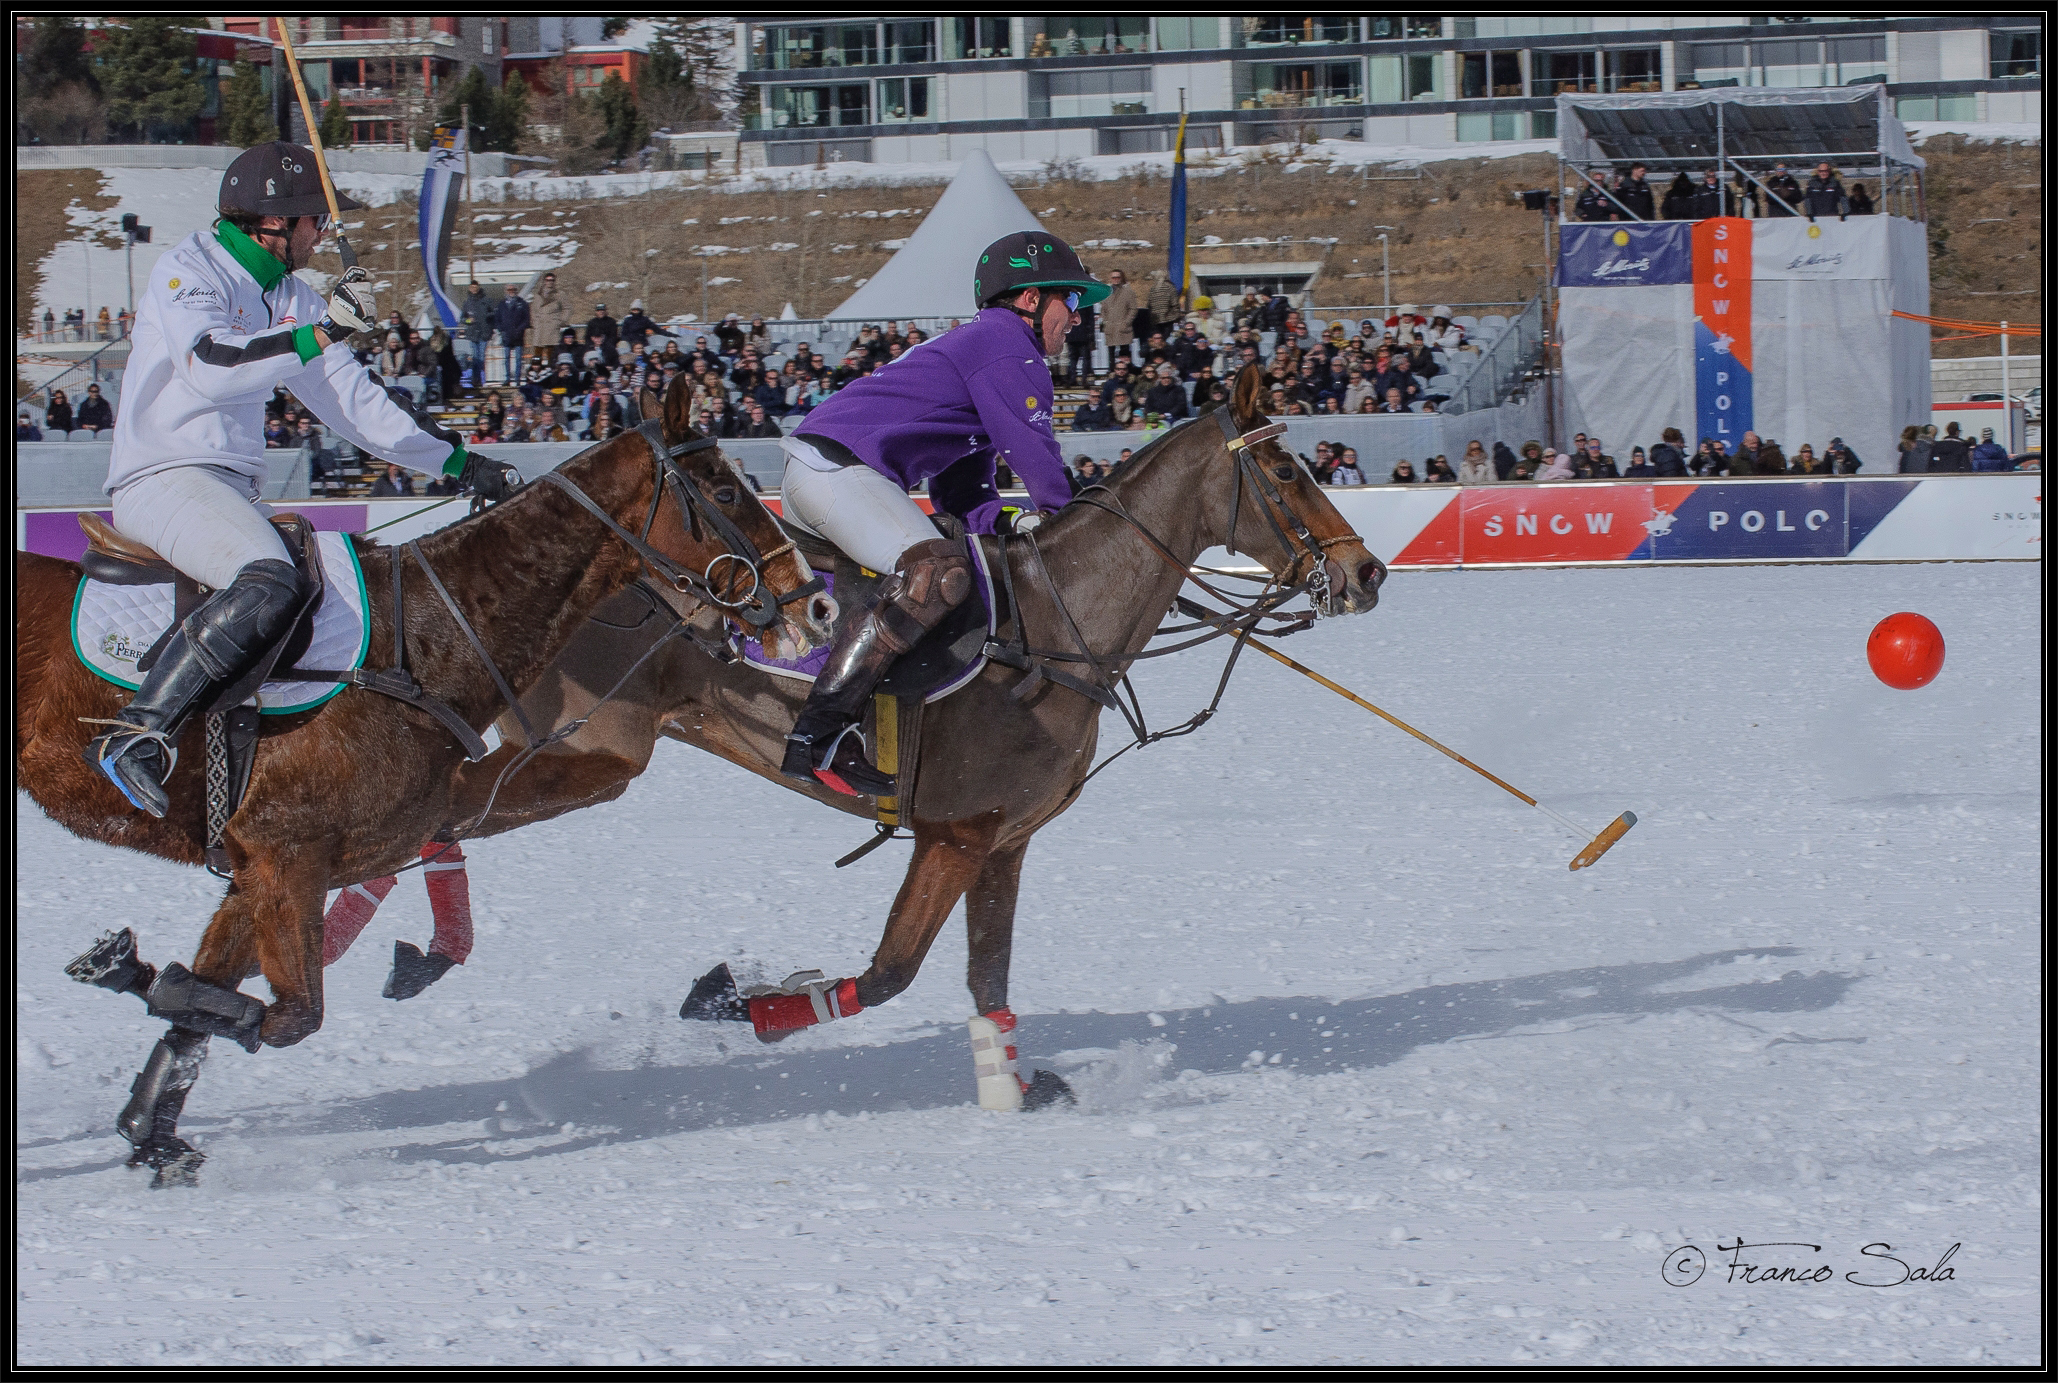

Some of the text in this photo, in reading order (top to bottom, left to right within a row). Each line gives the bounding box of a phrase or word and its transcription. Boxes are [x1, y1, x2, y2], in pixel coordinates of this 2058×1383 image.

[1712, 224, 1730, 315] SNOW
[1483, 509, 1830, 537] SNOW POLO
